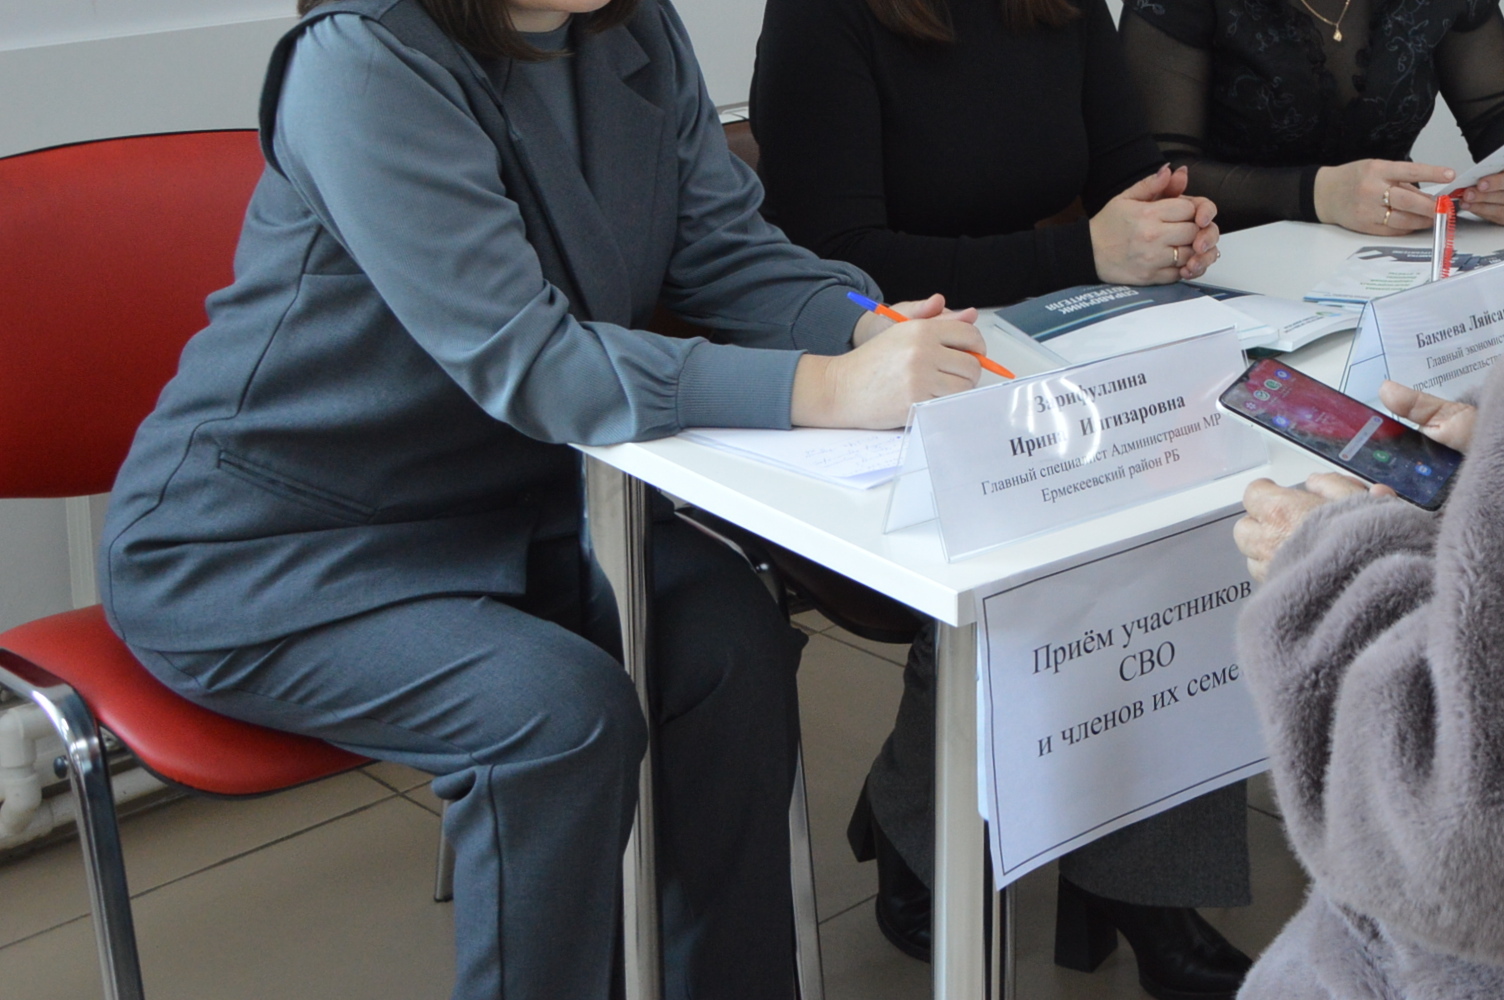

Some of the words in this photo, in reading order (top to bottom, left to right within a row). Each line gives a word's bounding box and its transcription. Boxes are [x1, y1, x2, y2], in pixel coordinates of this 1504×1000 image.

[1045, 286, 1131, 311] ПОТРЕБИТЕЛЯ
[1058, 290, 1139, 314] СПРАВОЧНИК
[1415, 322, 1466, 349] Бакиева
[1412, 354, 1502, 392] предпринимательст
[1426, 346, 1464, 370] Главный
[981, 466, 1037, 496] Главный
[1111, 421, 1201, 457] Администрации
[1203, 412, 1222, 429] МР
[1008, 429, 1069, 458] Ирина
[1041, 465, 1126, 503] Ермекеевский
[1128, 457, 1163, 480] район
[1164, 448, 1181, 464] РБ
[1032, 629, 1114, 674] Приём
[1121, 580, 1252, 649] участников
[1118, 640, 1176, 682] СВО
[1037, 735, 1053, 757] и
[1061, 700, 1145, 746] членов
[1152, 685, 1180, 712] их
[1186, 662, 1244, 698] семе
